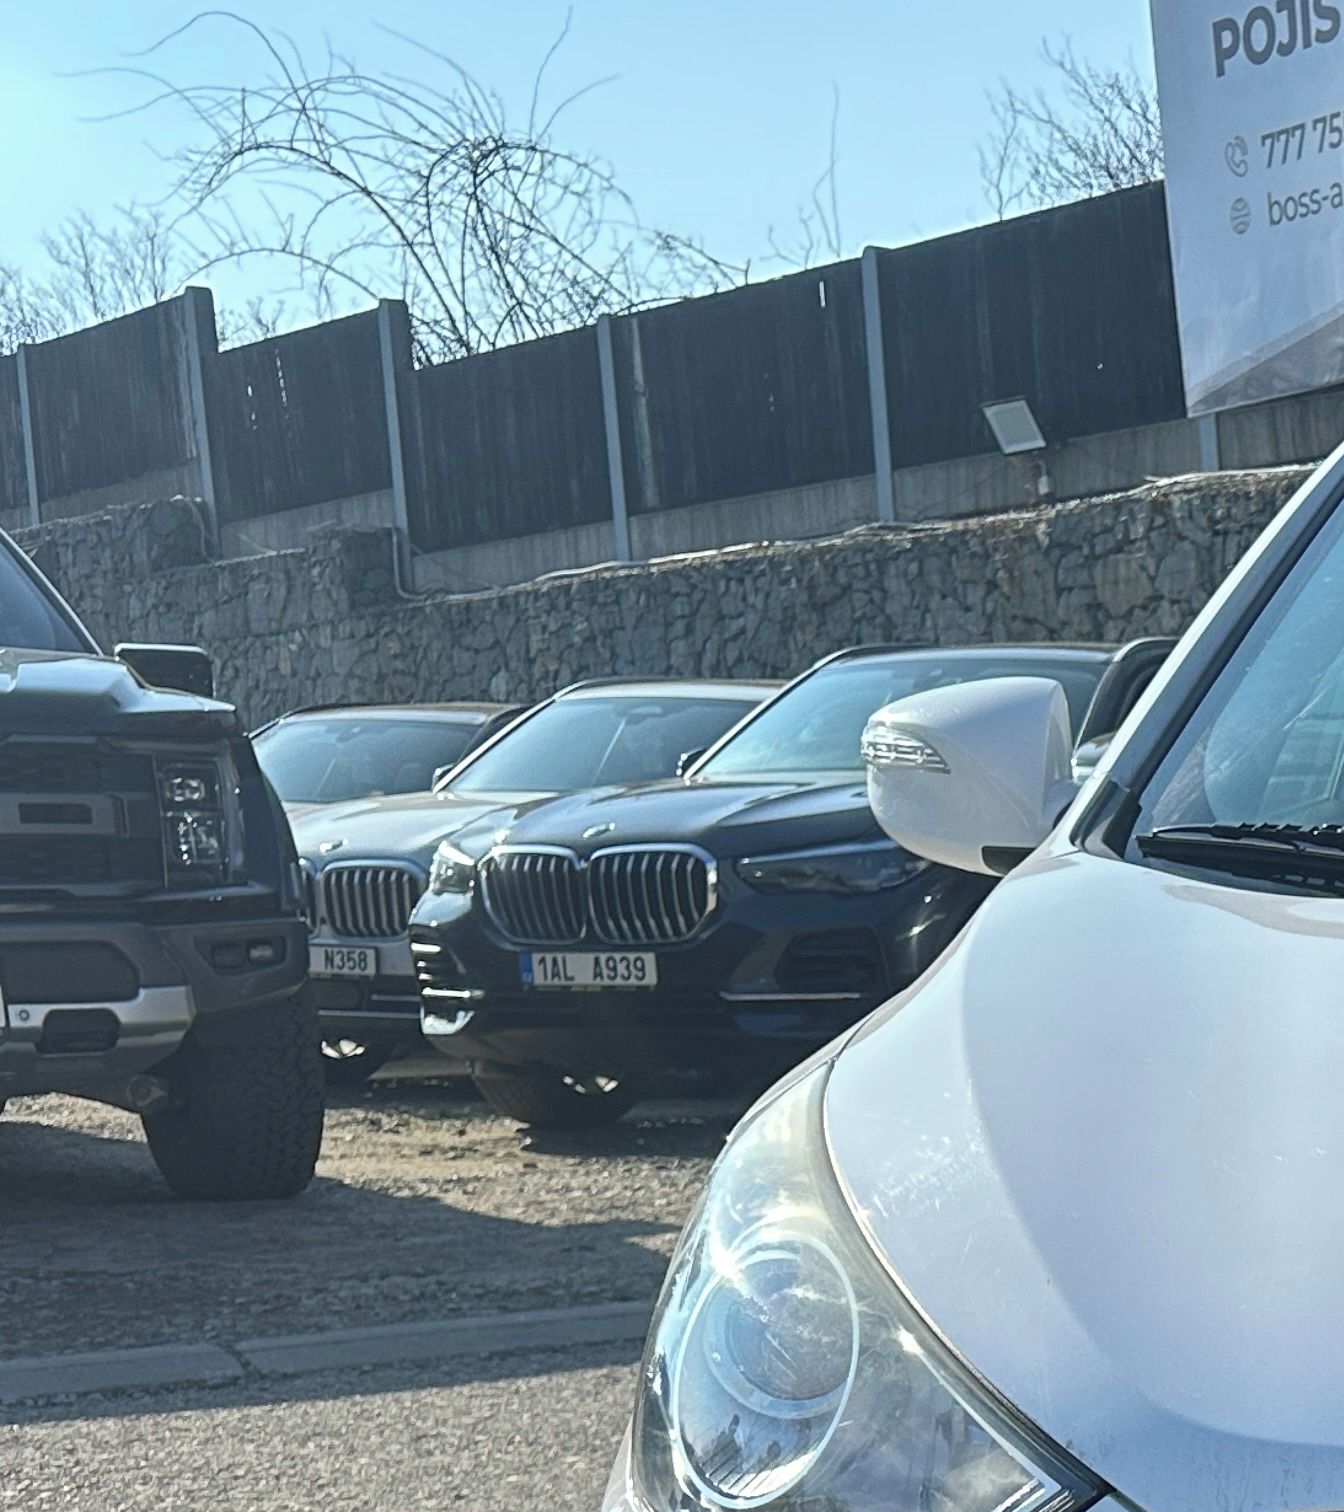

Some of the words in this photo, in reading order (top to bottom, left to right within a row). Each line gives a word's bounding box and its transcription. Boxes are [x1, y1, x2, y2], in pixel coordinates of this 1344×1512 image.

[1260, 122, 1306, 168] 777
[324, 948, 368, 972] N358
[538, 955, 575, 981] 1AL
[593, 955, 646, 981] A939
